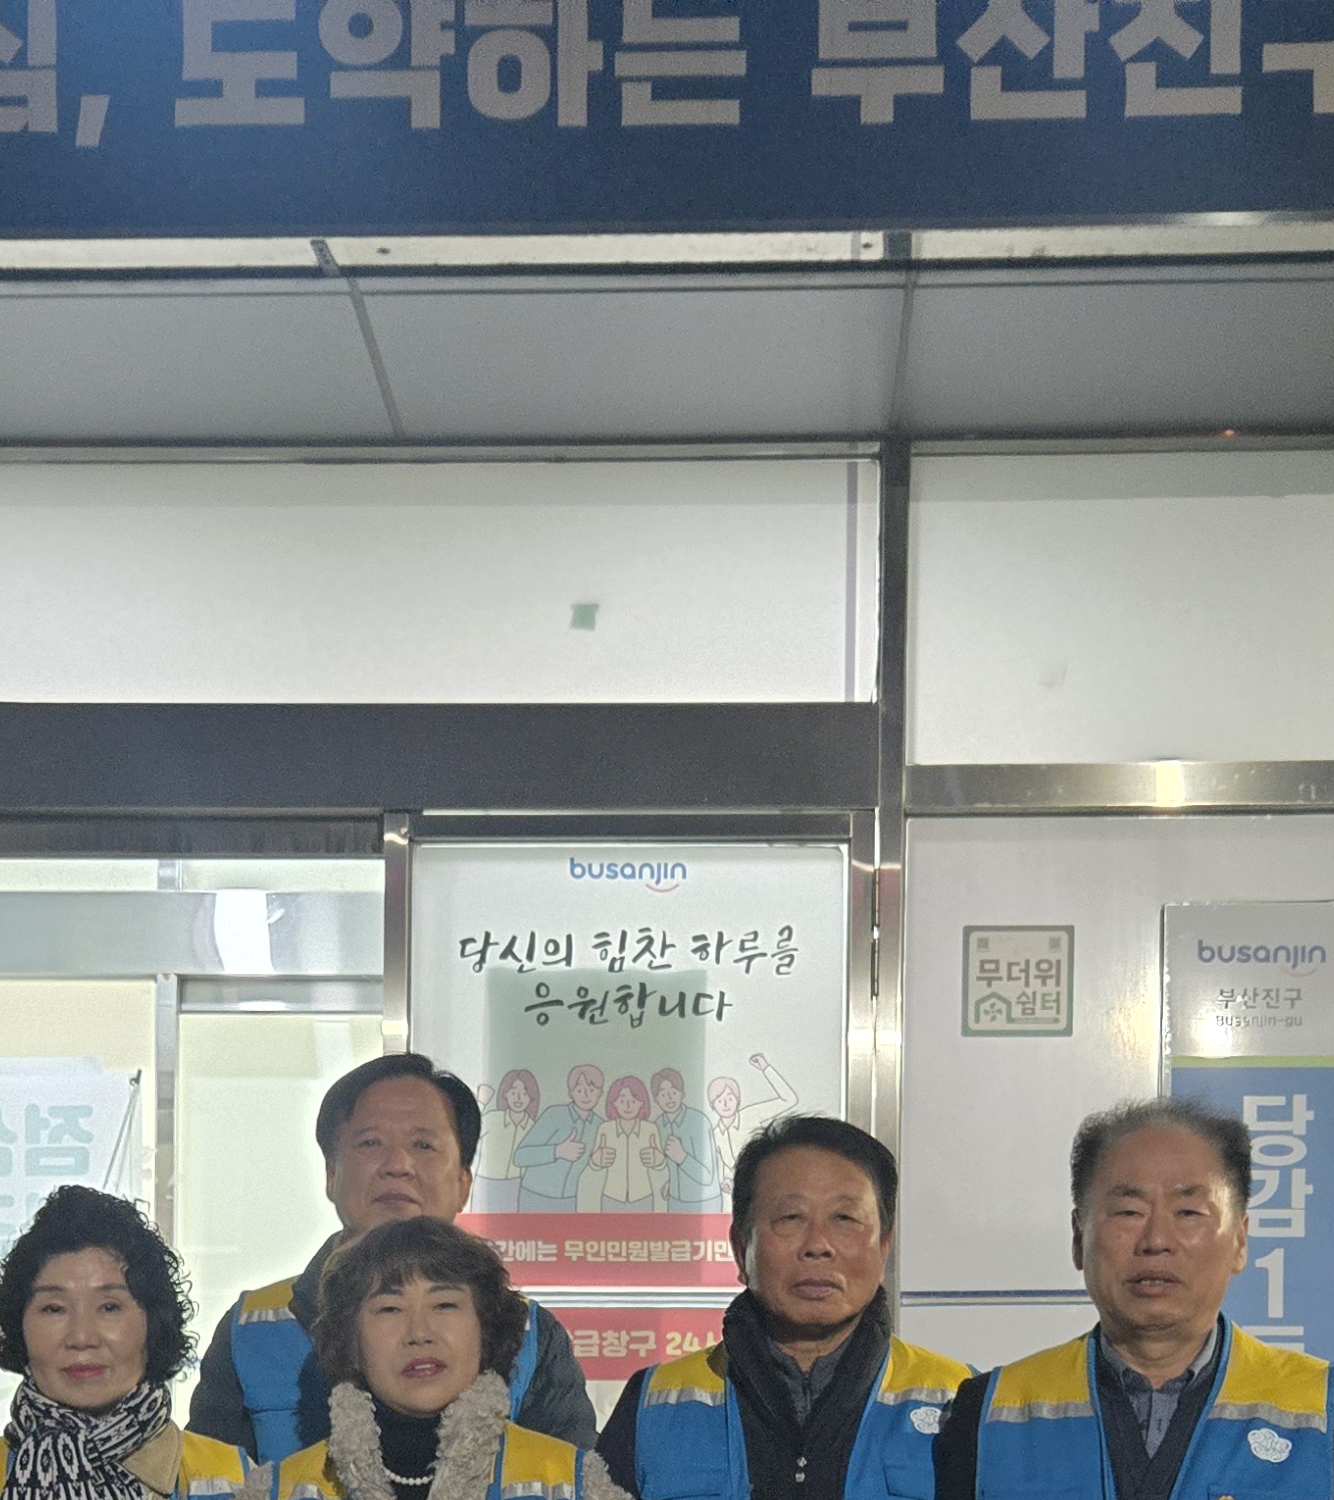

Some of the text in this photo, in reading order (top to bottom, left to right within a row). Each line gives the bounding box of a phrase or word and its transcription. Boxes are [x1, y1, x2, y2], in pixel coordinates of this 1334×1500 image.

[174, 0, 747, 128] 도약하는
[569, 858, 688, 886] busanjin
[458, 924, 799, 976] 당신의 힘찬 하루를
[1197, 939, 1327, 970] busanjin
[975, 958, 1062, 988] 무더위
[524, 981, 734, 1029] 응원합니다
[1015, 990, 1061, 1016] 쉼터
[1216, 987, 1303, 1010] 부산진구
[487, 1240, 558, 1262] 간에는
[567, 1329, 657, 1358] 급창구
